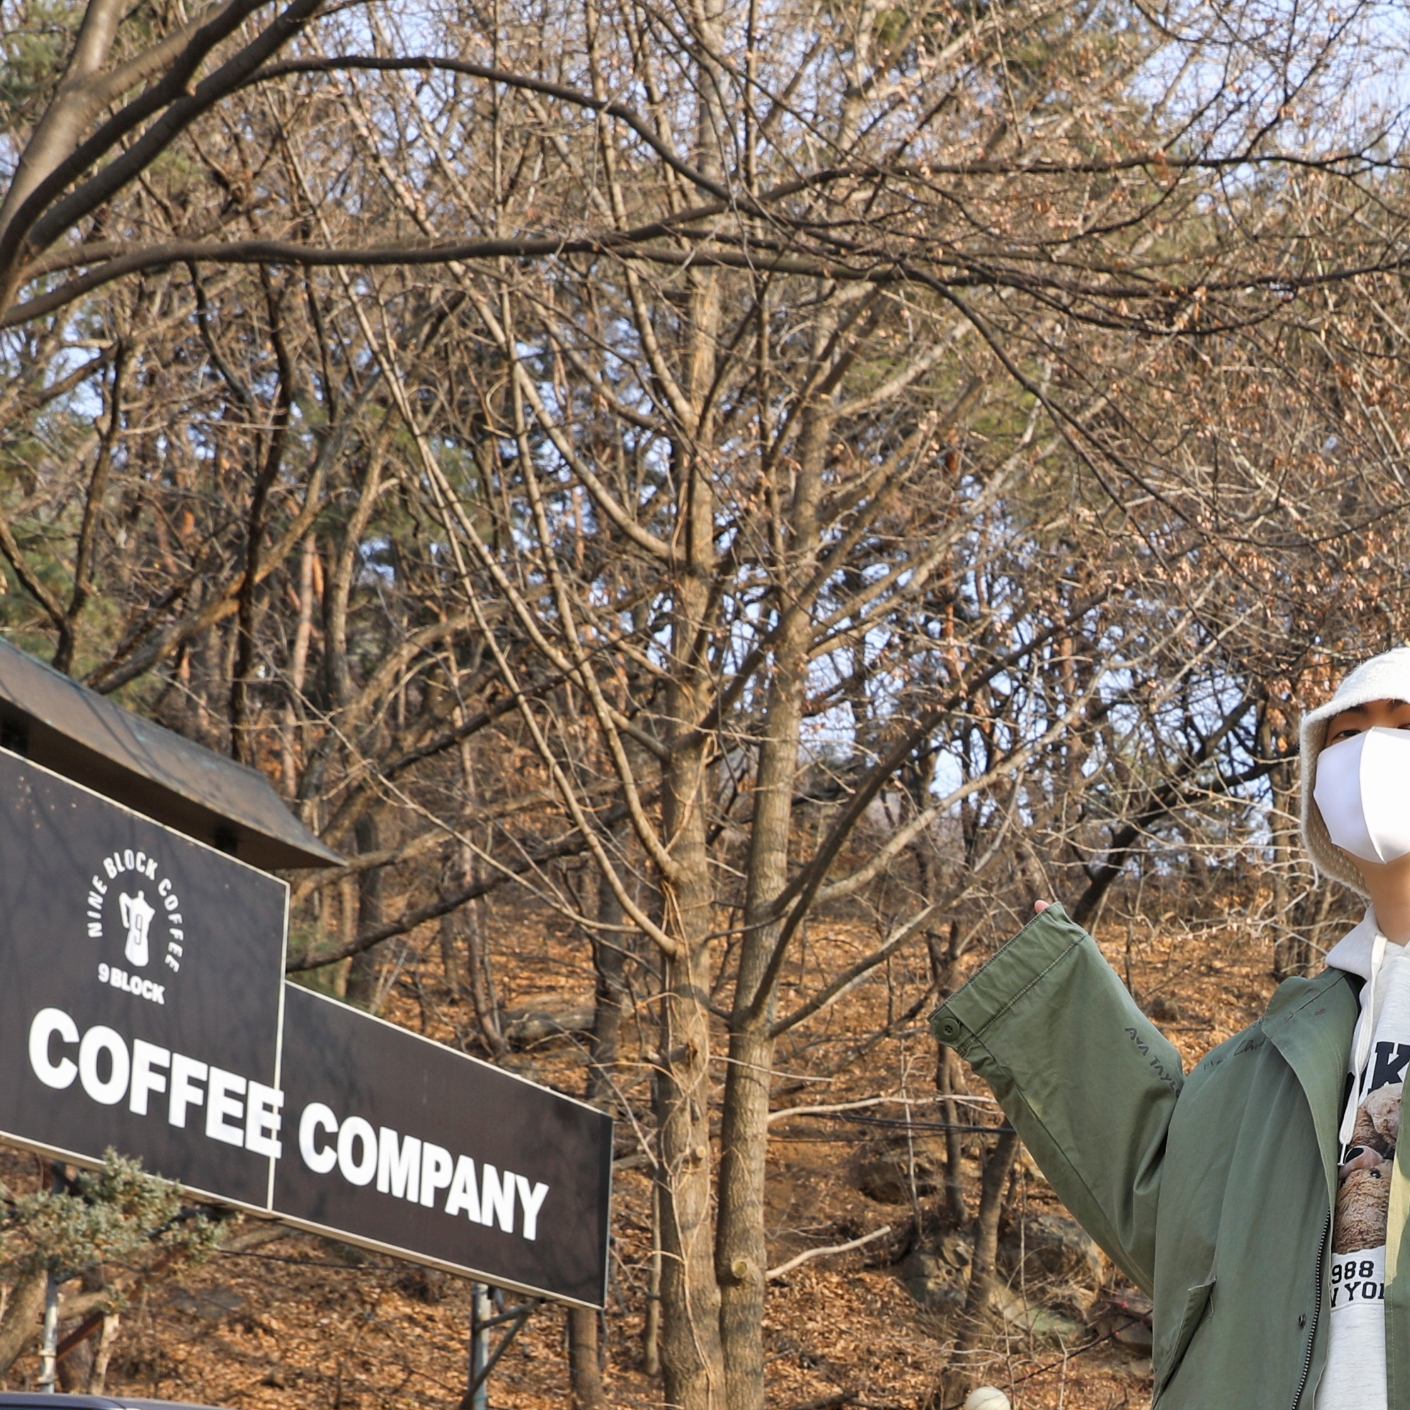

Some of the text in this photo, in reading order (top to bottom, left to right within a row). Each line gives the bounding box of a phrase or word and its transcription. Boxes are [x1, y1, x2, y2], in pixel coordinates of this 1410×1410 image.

[87, 849, 184, 973] NINE BLOCK COFFEE
[98, 962, 165, 1005] 9 BLOCK
[28, 1007, 549, 1241] COFFEE COMPANY
